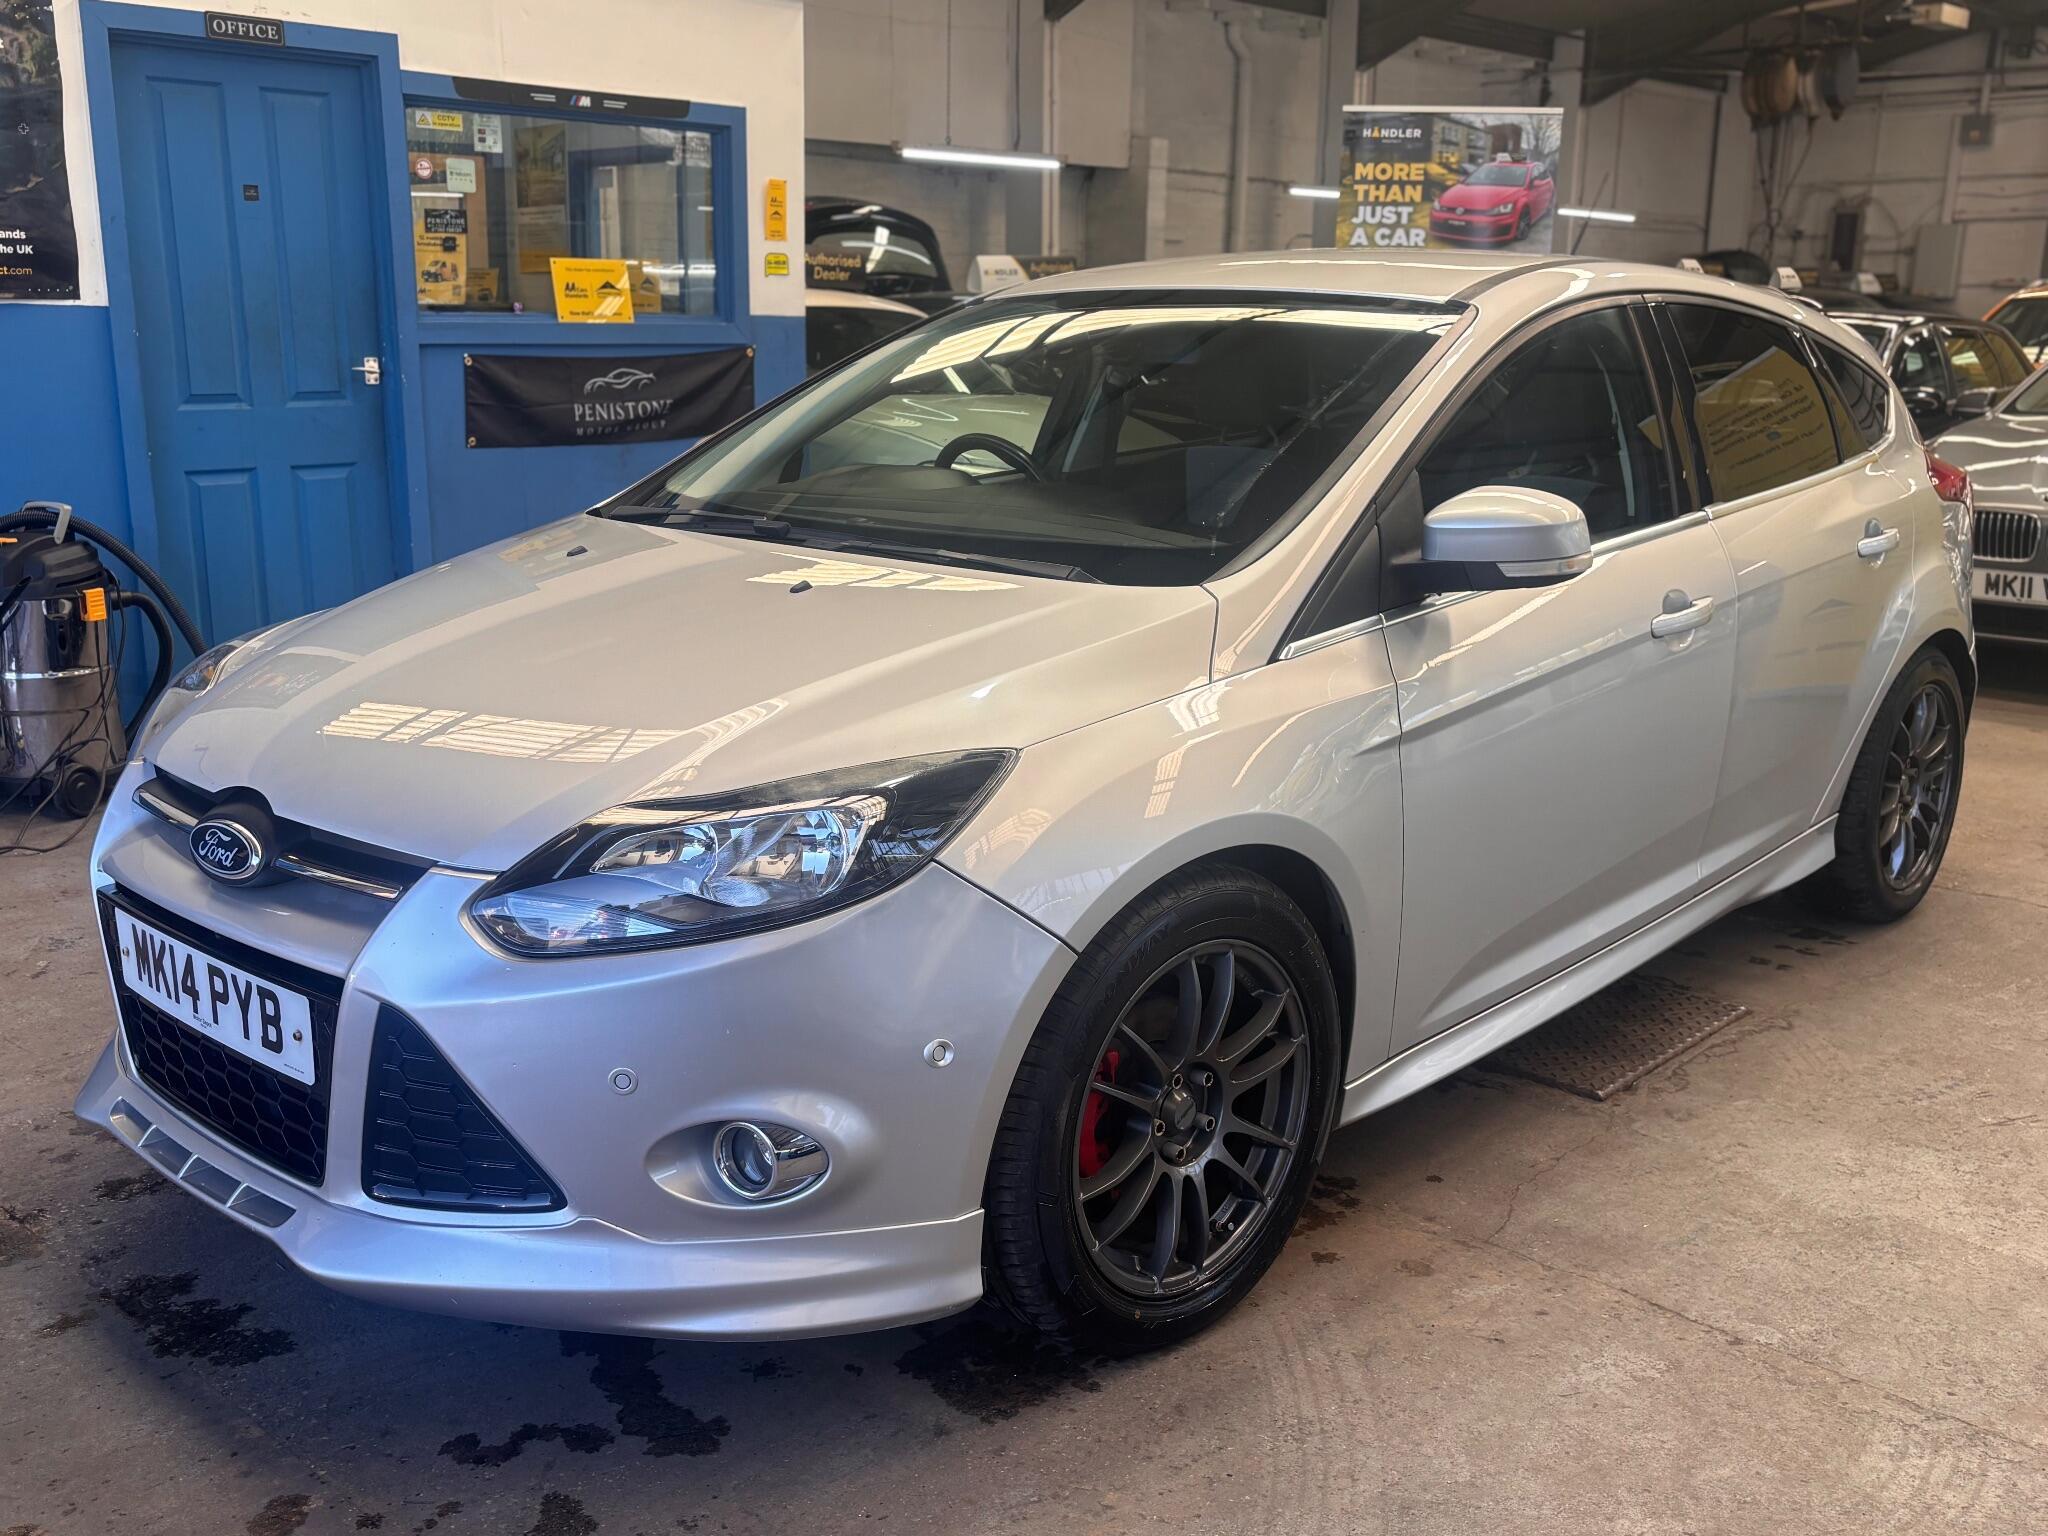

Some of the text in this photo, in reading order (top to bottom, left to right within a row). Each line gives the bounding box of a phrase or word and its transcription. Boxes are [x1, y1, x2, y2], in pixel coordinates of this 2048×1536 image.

[213, 19, 279, 39] OFFICE
[1355, 162, 1425, 181] MORE
[1353, 184, 1423, 202] THAN
[1351, 205, 1414, 225] JUST
[1350, 227, 1426, 246] A CAR
[16, 244, 34, 255] UK
[814, 266, 850, 281] Dealer
[574, 399, 674, 422] PENISTONE
[1985, 572, 2034, 599] MK11
[198, 828, 239, 867] Ford
[131, 923, 284, 1055] MK14 PYB
